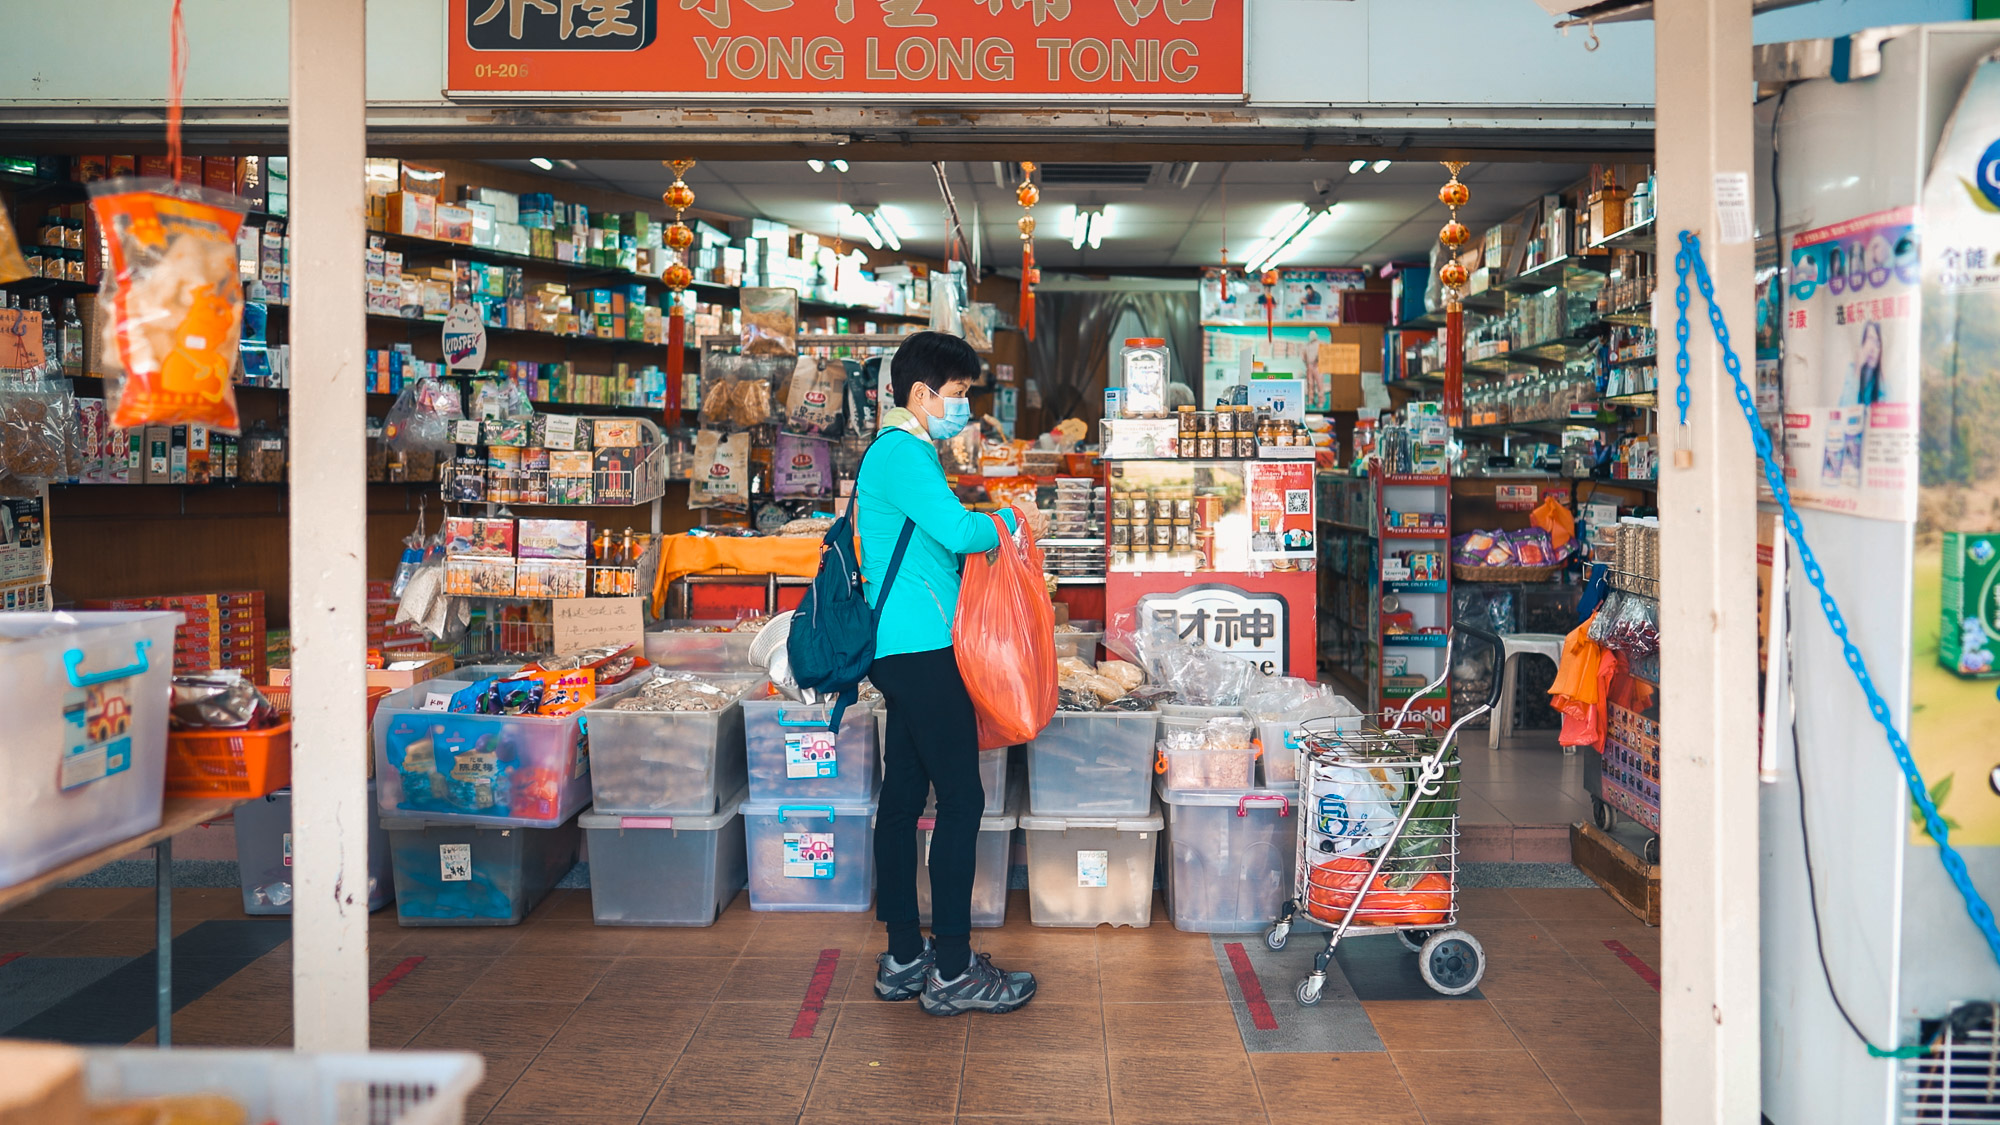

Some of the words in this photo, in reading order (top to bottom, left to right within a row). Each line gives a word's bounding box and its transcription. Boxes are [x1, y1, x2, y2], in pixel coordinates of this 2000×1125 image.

[693, 36, 844, 80] YONG
[866, 36, 1014, 81] LONG
[1036, 37, 1199, 83] TONIC
[475, 63, 529, 79] 01-206
[1383, 705, 1446, 723] Panadol
